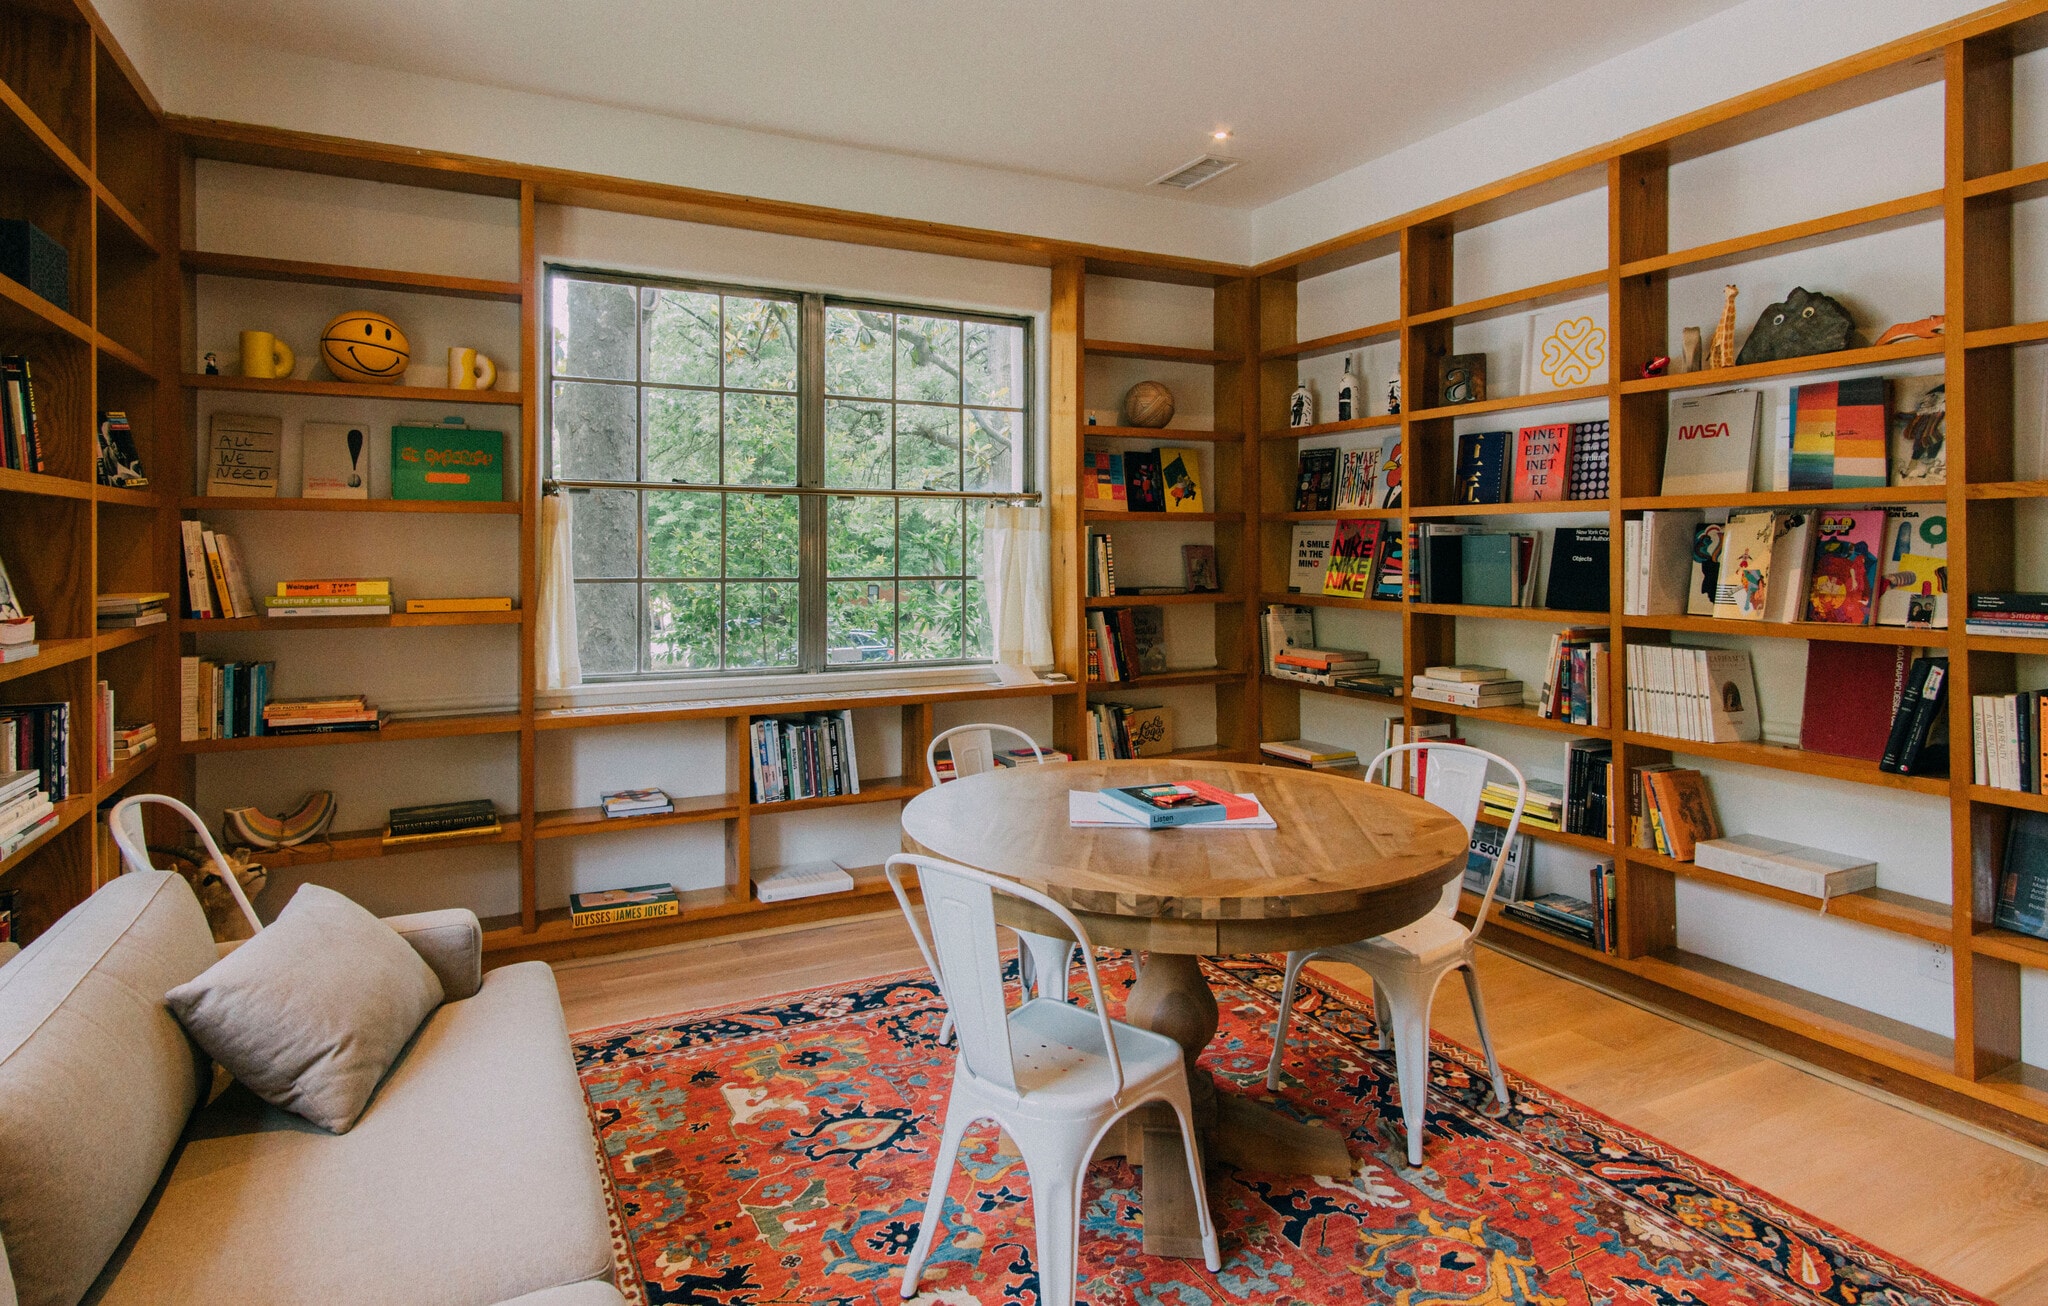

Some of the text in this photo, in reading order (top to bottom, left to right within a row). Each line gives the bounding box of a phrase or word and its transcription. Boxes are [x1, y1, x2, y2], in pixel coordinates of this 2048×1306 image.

[1523, 427, 1566, 441] NINET
[1678, 422, 1729, 441] NASA
[219, 434, 254, 448] ALL
[1525, 443, 1561, 456] EENN
[220, 450, 247, 466] WE
[1343, 450, 1380, 465] BEWARE
[1526, 459, 1556, 471] INET
[216, 467, 269, 480] NEED
[1532, 475, 1547, 485] EE
[1534, 490, 1543, 501] N
[1299, 540, 1330, 549] A SMILE
[1333, 539, 1373, 558] NIKE
[1299, 550, 1323, 558] IN THE
[1329, 557, 1369, 575] NIKE
[1325, 572, 1366, 592] NIKE
[2010, 612, 2041, 620] Smoke
[1894, 660, 1904, 690] GRAPHIC
[393, 821, 439, 831] TREASURES
[454, 815, 485, 824] BRITAIN
[1153, 814, 1174, 823] Listen
[1479, 843, 1516, 863] SOUH
[574, 903, 668, 927] ULYSSES JAMES JOYCE
